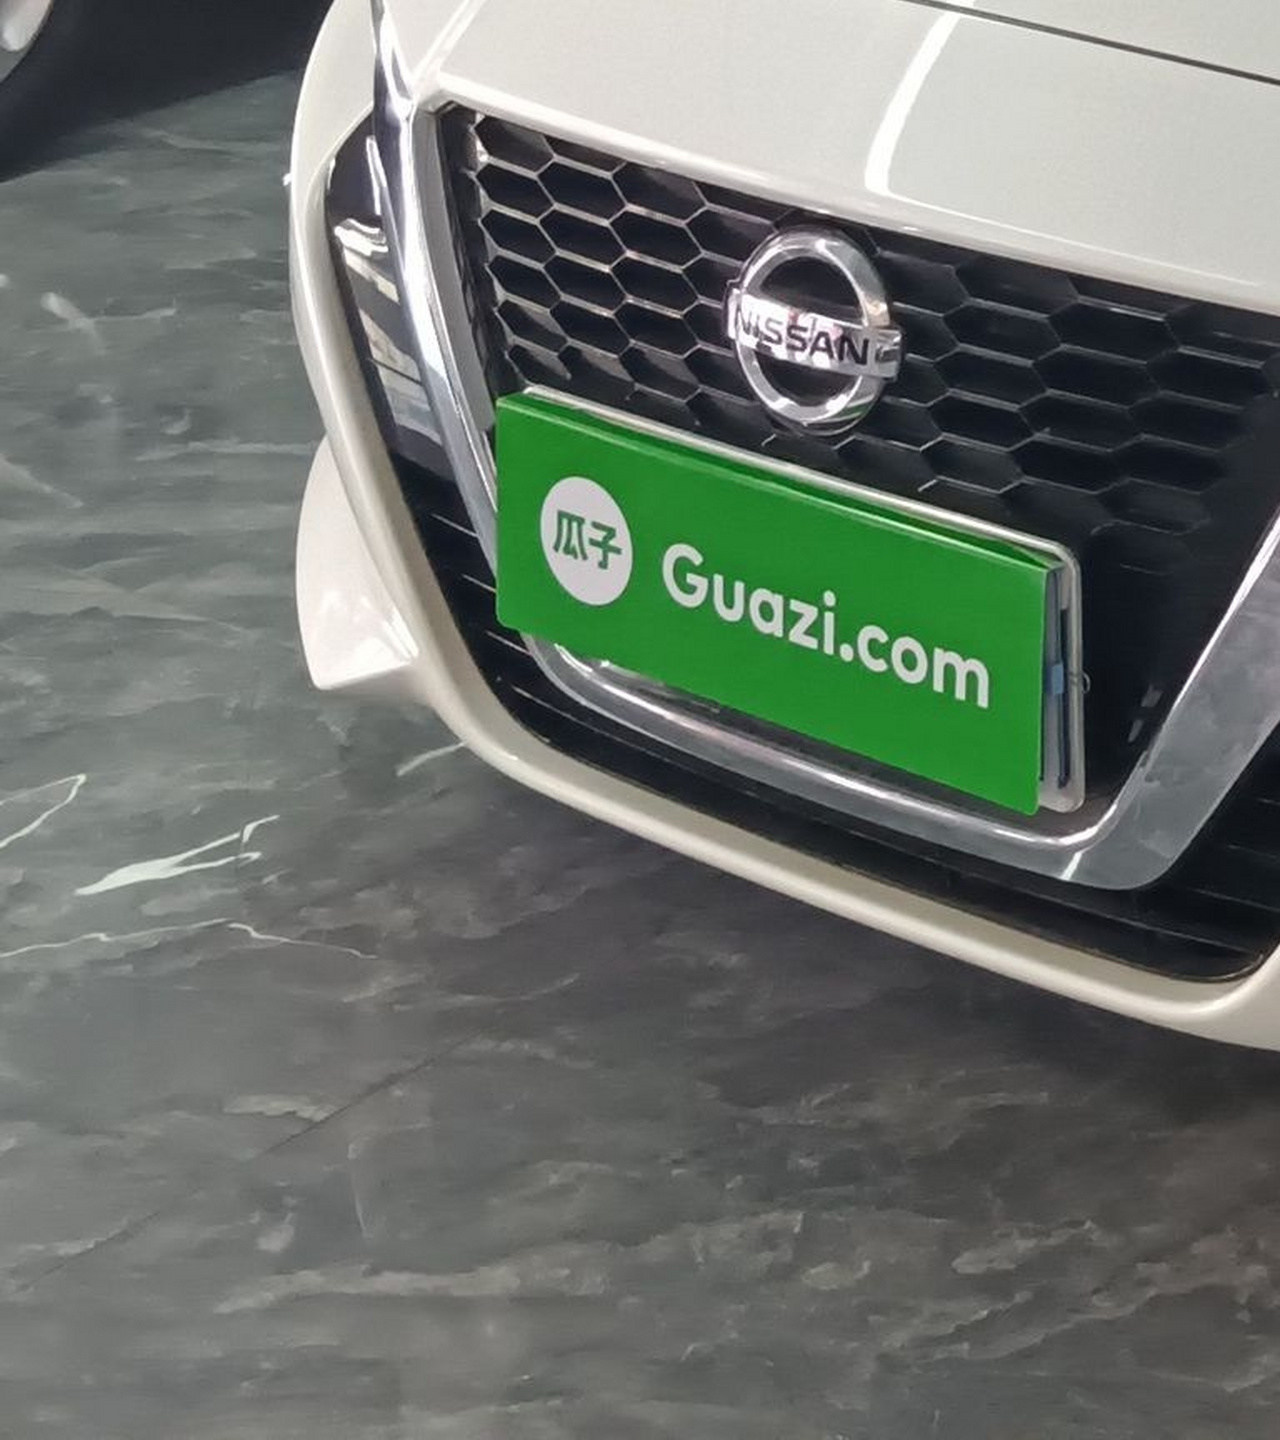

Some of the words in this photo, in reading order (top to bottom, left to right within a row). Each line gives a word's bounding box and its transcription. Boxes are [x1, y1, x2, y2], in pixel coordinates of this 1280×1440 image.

[737, 309, 869, 366] NISSAN
[553, 509, 623, 570] 瓜子
[662, 543, 989, 709] Guazi.com
